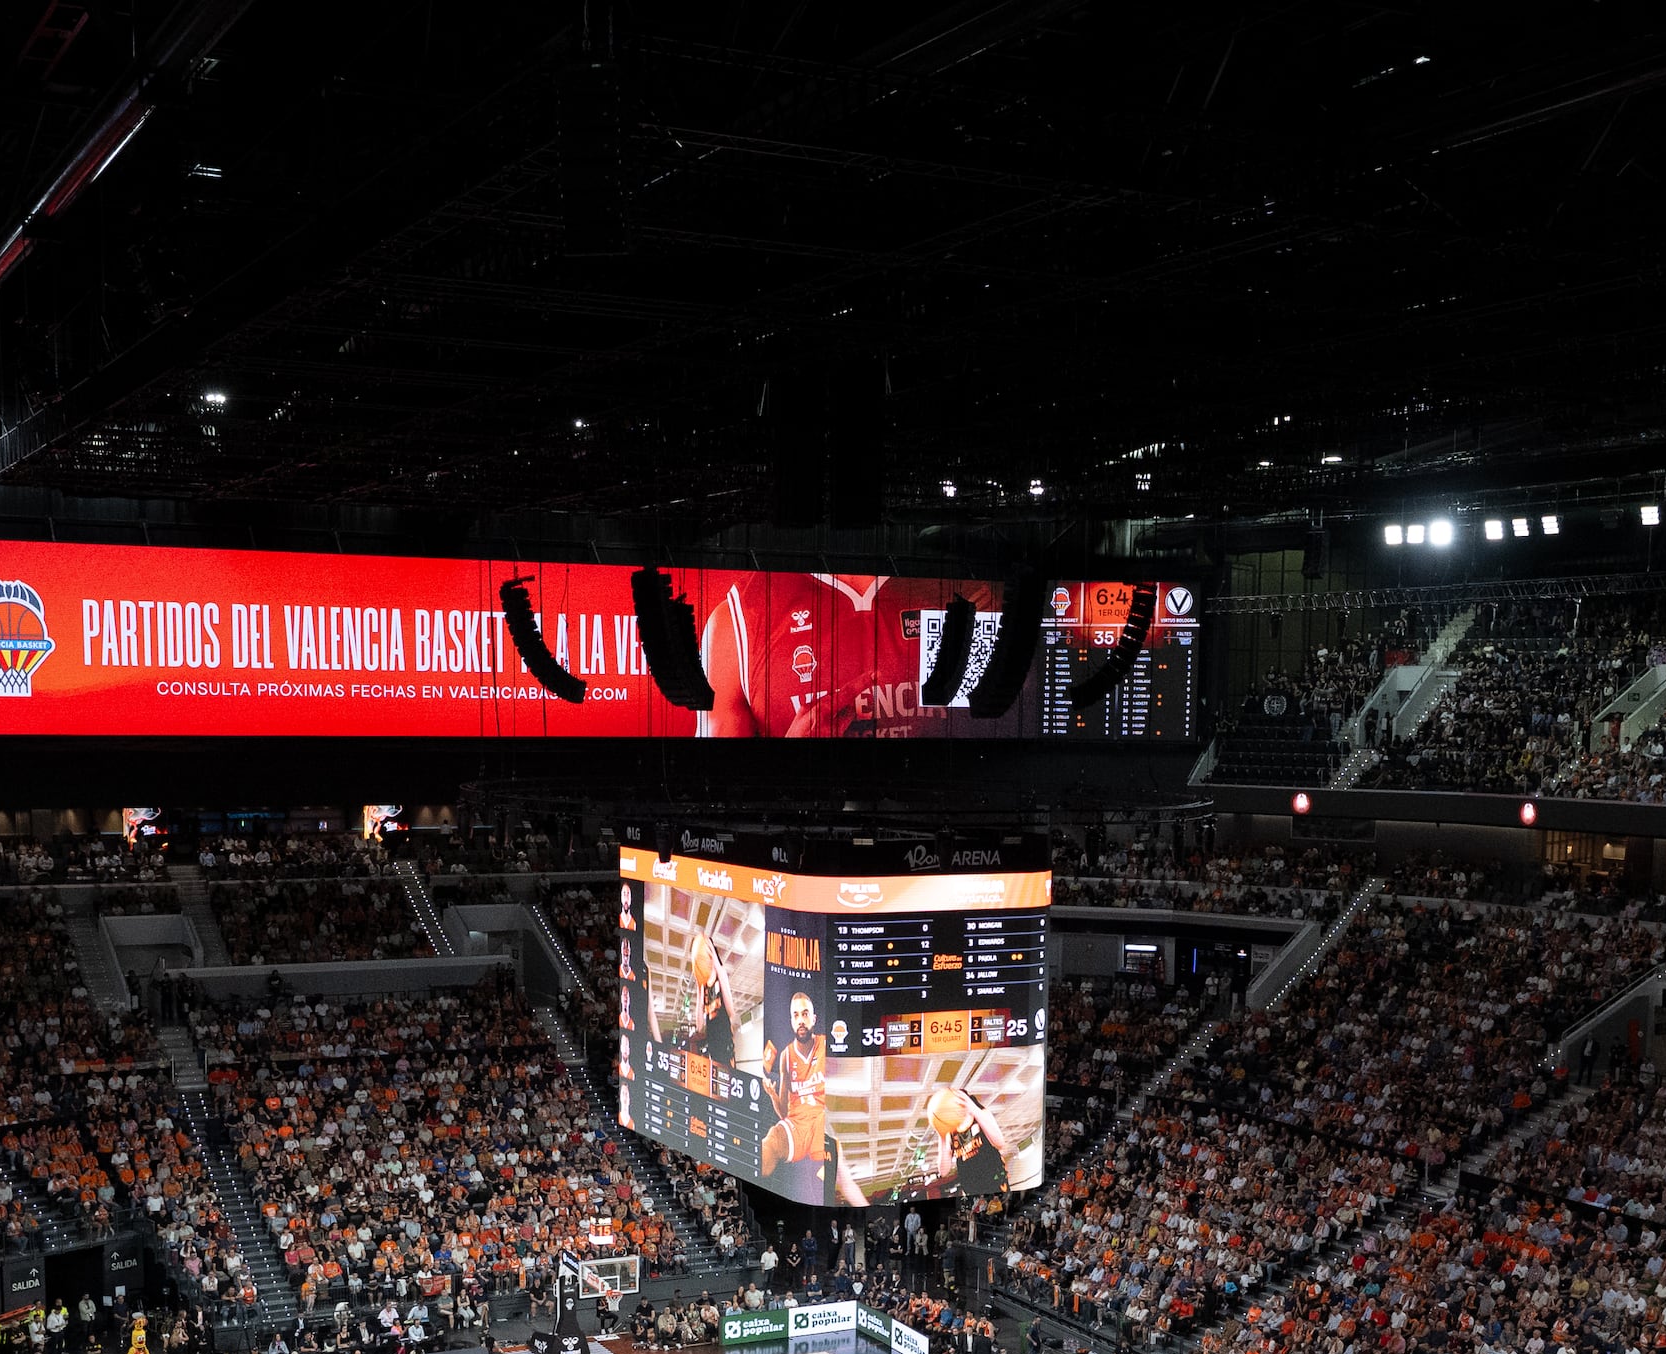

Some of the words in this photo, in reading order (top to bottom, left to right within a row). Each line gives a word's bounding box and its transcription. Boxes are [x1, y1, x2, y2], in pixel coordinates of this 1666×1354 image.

[83, 599, 220, 668] PARTIDOS
[232, 603, 274, 669] DEL
[284, 605, 405, 672] VALENCIA
[415, 609, 507, 673] BASKET
[579, 613, 605, 675] LA
[1094, 631, 1114, 645] 35
[17, 641, 47, 649] BASKET
[157, 681, 251, 697] CONSULTA
[257, 679, 344, 697] PRÓXIMAS
[352, 684, 416, 698] FECHAS
[422, 685, 443, 698] EN
[632, 828, 641, 840] LG
[701, 838, 725, 854] ARENA
[951, 850, 1001, 866] ARENA
[753, 878, 775, 897] MGS
[967, 922, 976, 930] 30
[838, 943, 848, 951] 10
[840, 960, 845, 968] 1
[968, 955, 973, 963] 6
[933, 961, 963, 971] Esfuerzo
[851, 977, 879, 985] COSTELLO
[837, 994, 847, 1002] 77
[888, 1024, 909, 1032] FALTES
[913, 1022, 919, 1032] 2
[930, 1019, 962, 1034] 6:45
[973, 1019, 979, 1028] 2
[984, 1018, 1003, 1026] FALTES
[1007, 1019, 1028, 1037] 25
[862, 1028, 885, 1046] 35
[942, 1035, 961, 1043] QUART
[658, 1051, 669, 1071] 35
[731, 1077, 744, 1099] 25
[111, 1258, 138, 1271] SALIDA
[12, 1279, 40, 1292] SALIDA
[812, 1310, 838, 1319] caixa
[812, 1314, 852, 1327] popular
[867, 1312, 883, 1327] caixa
[743, 1319, 769, 1327] caixa
[743, 1322, 785, 1336] popular
[866, 1320, 891, 1338] popular
[904, 1331, 918, 1345] caixa
